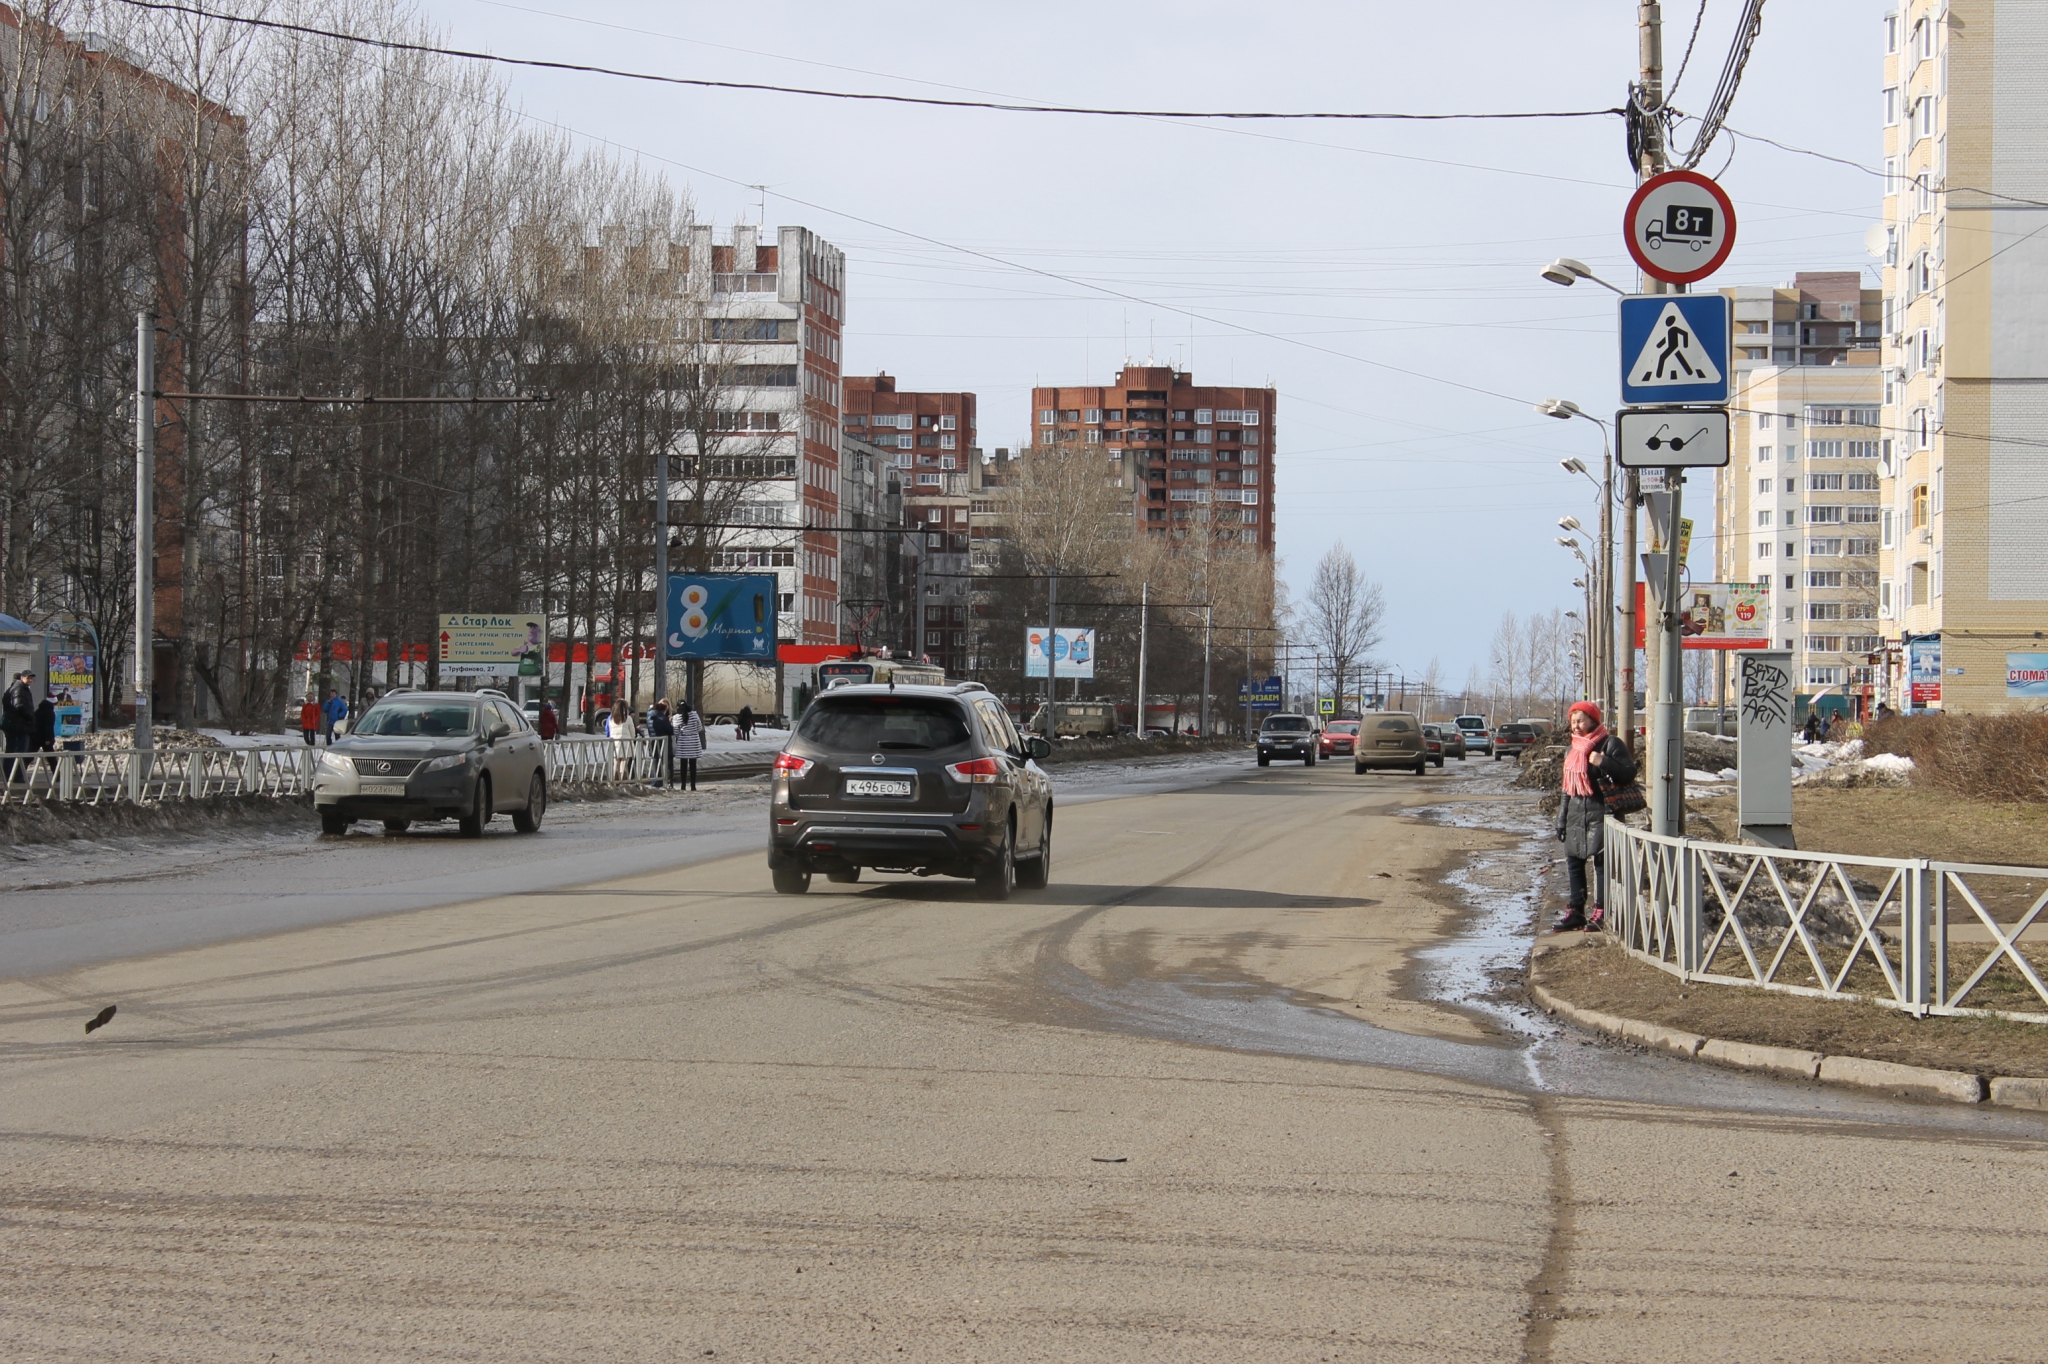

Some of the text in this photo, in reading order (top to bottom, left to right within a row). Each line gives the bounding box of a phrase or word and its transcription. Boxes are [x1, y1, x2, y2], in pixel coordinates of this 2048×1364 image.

[462, 615, 511, 628] Стар Лок
[50, 672, 94, 684] Маменко
[897, 782, 908, 791] 76
